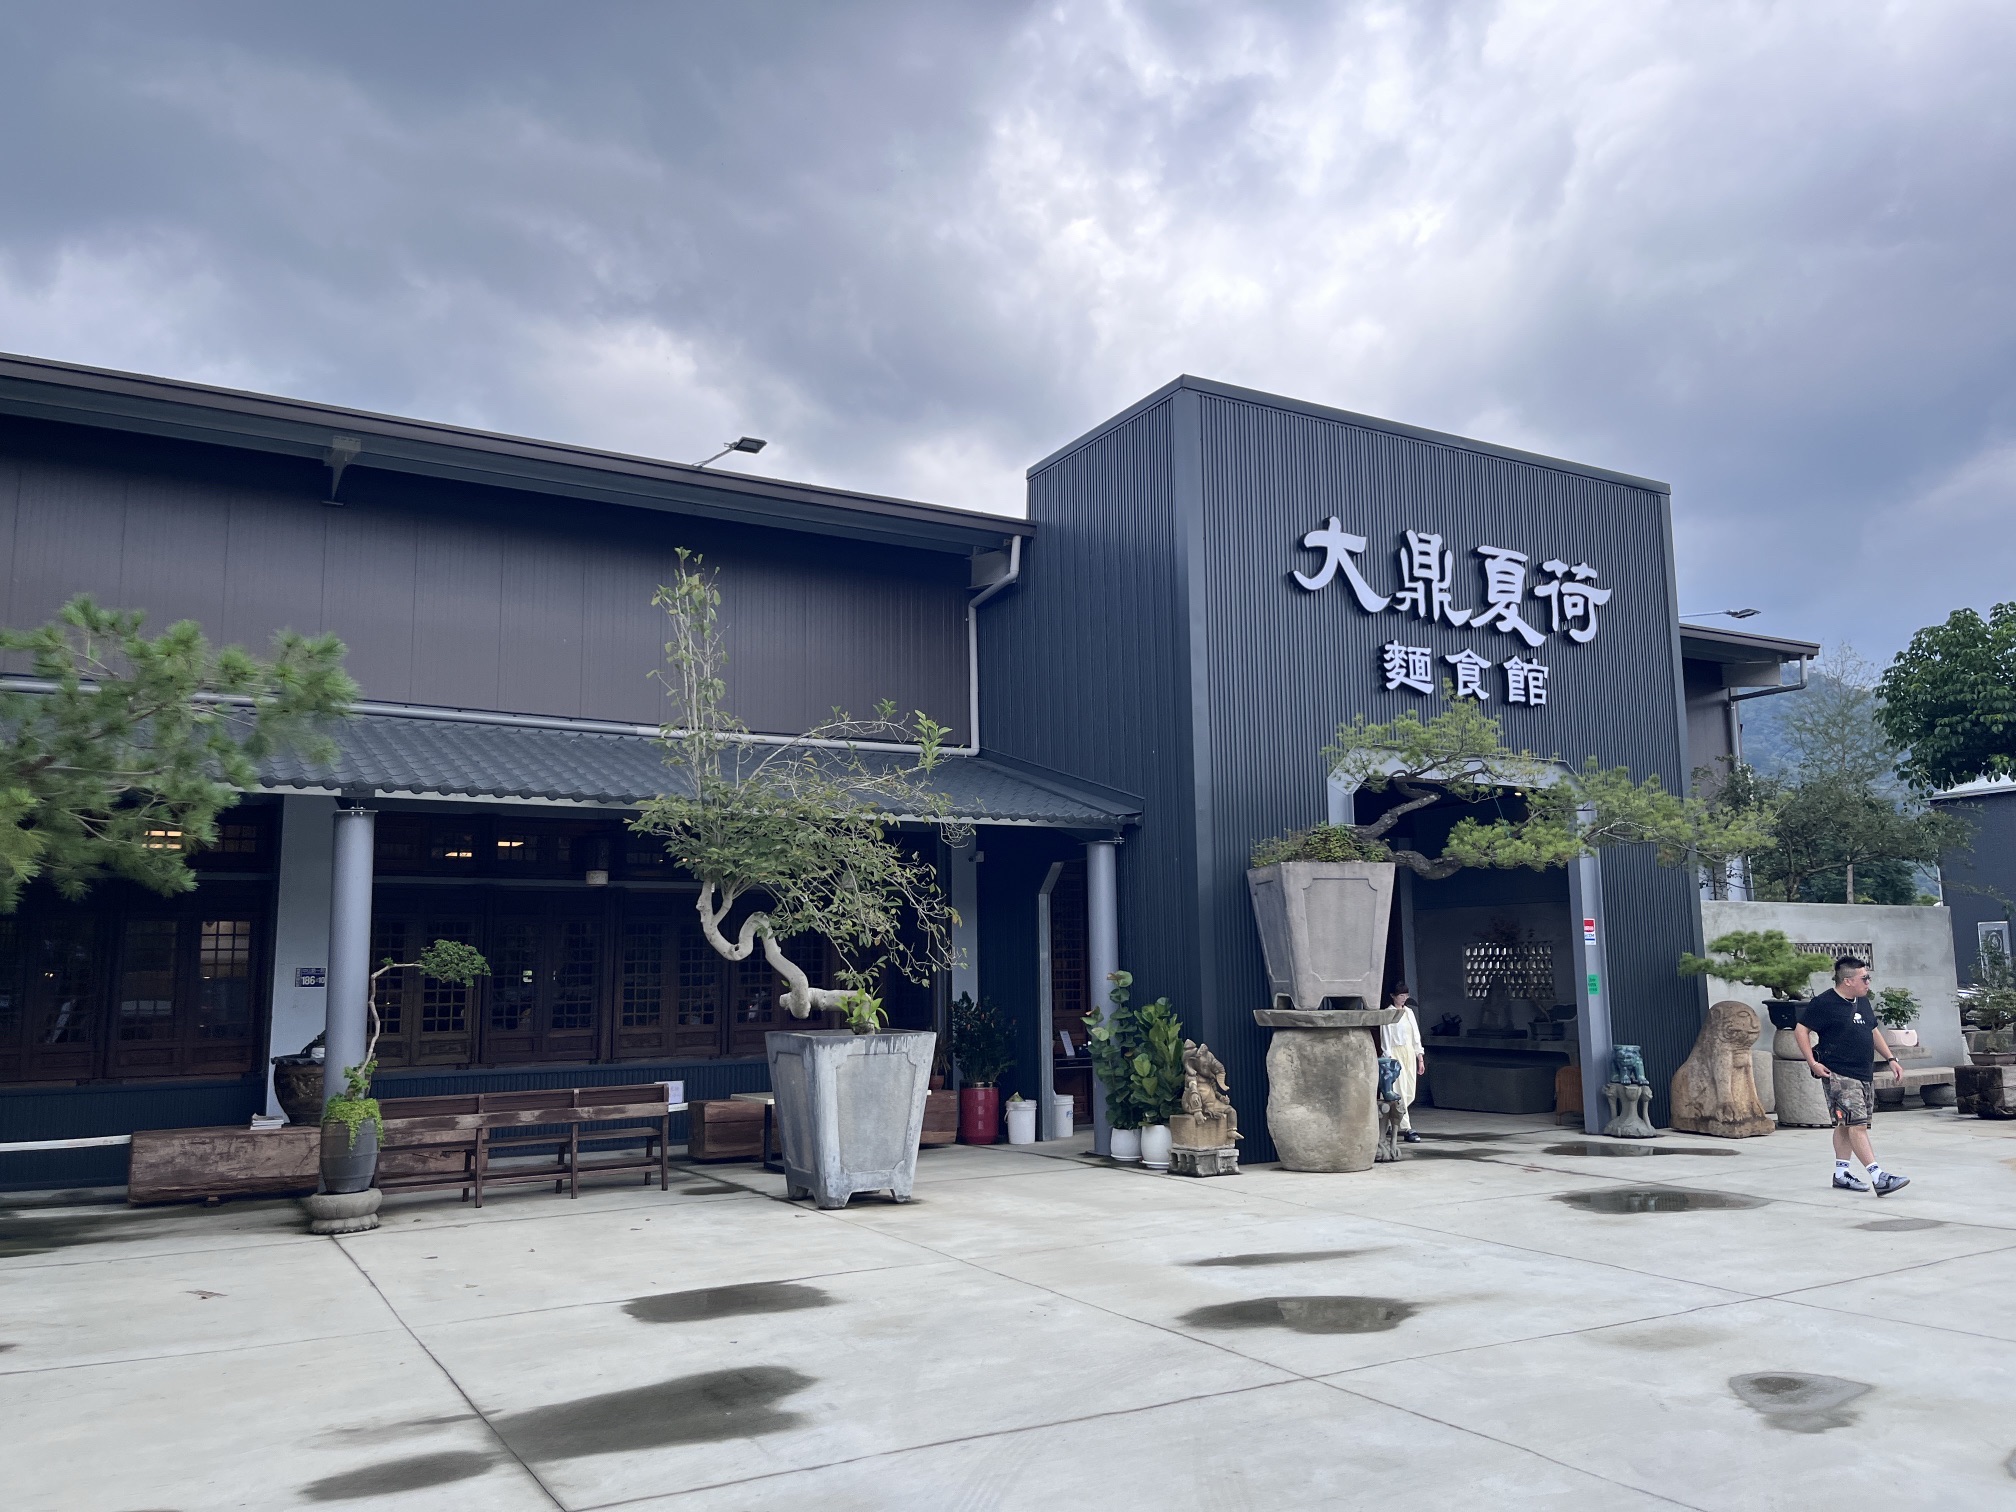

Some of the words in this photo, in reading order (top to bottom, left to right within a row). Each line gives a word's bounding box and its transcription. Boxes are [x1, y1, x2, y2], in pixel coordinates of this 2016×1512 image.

[1292, 515, 1612, 648] 大鼎夏荷
[1383, 639, 1549, 706] 麵食館
